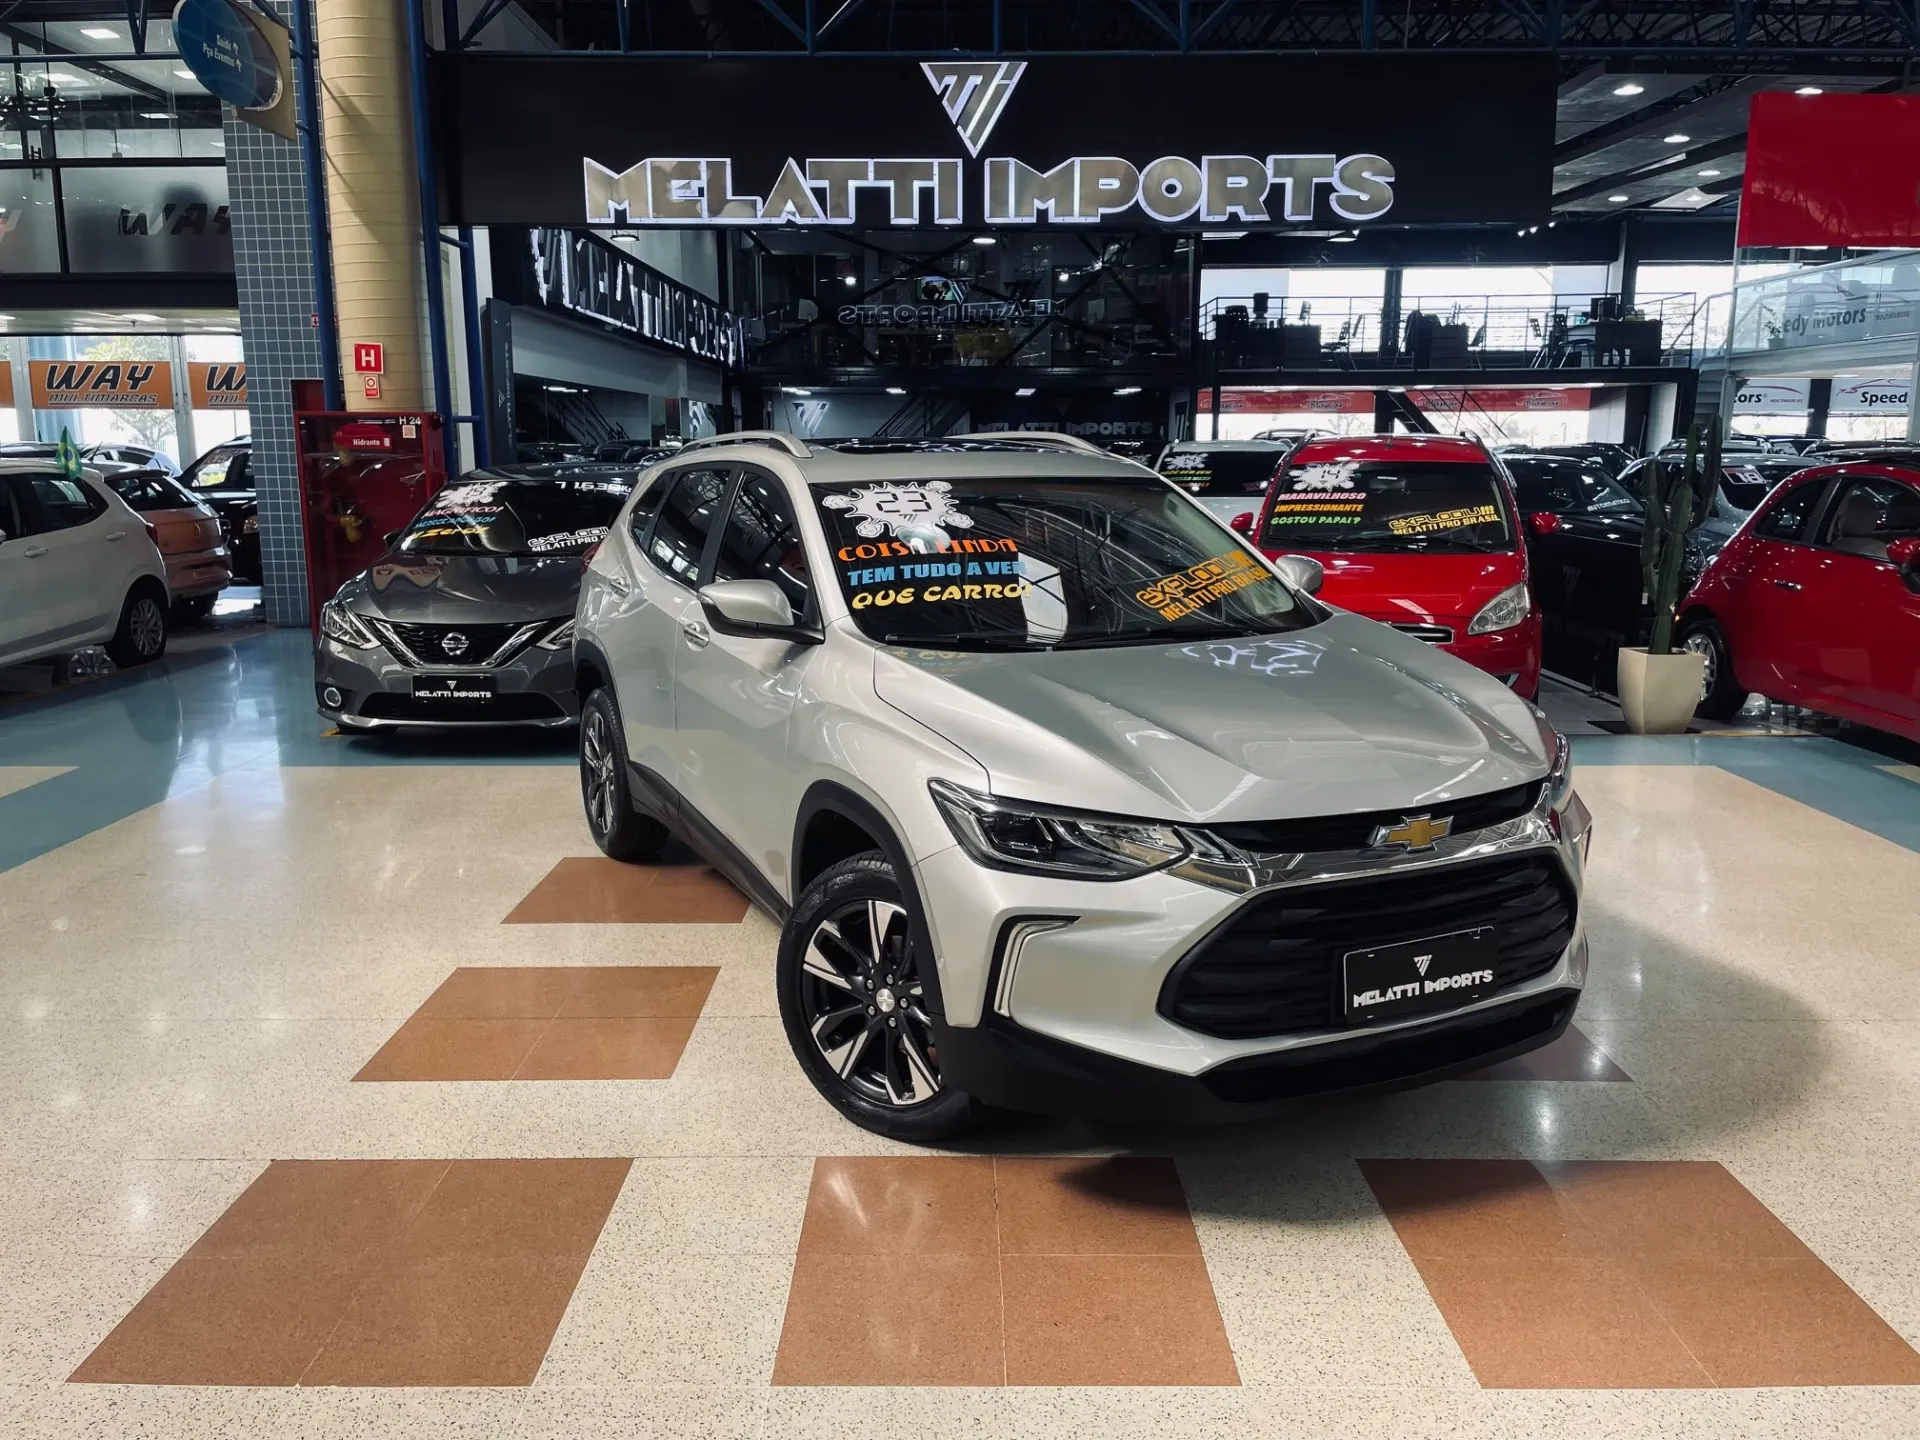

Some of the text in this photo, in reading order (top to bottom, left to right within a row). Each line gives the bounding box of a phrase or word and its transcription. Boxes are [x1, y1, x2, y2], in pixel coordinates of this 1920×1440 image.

[584, 154, 1396, 224] MELATTI IMPORTS
[361, 348, 376, 368] H
[46, 363, 155, 391] WAY
[399, 417, 408, 425] H
[1065, 421, 1154, 435] IMPORTS
[1321, 469, 1341, 479] 14
[874, 491, 932, 513] 23
[1277, 492, 1367, 501] MARAVILHOSO
[1274, 503, 1365, 513] IMPRESSIONANTE
[1271, 516, 1317, 525] GOSTOU
[1393, 513, 1501, 536] MELATTI PRO BRASIL
[532, 540, 576, 552] MELATTI
[577, 535, 599, 546] PRO
[838, 538, 1019, 562] COISA LINDA
[848, 561, 1028, 587] TEM TUDO A VER
[852, 583, 1033, 609] QUE CARRO!
[1159, 567, 1273, 622] MELATTI PRO BRASIL
[1353, 969, 1494, 1008] MELATTI IMPORTS
